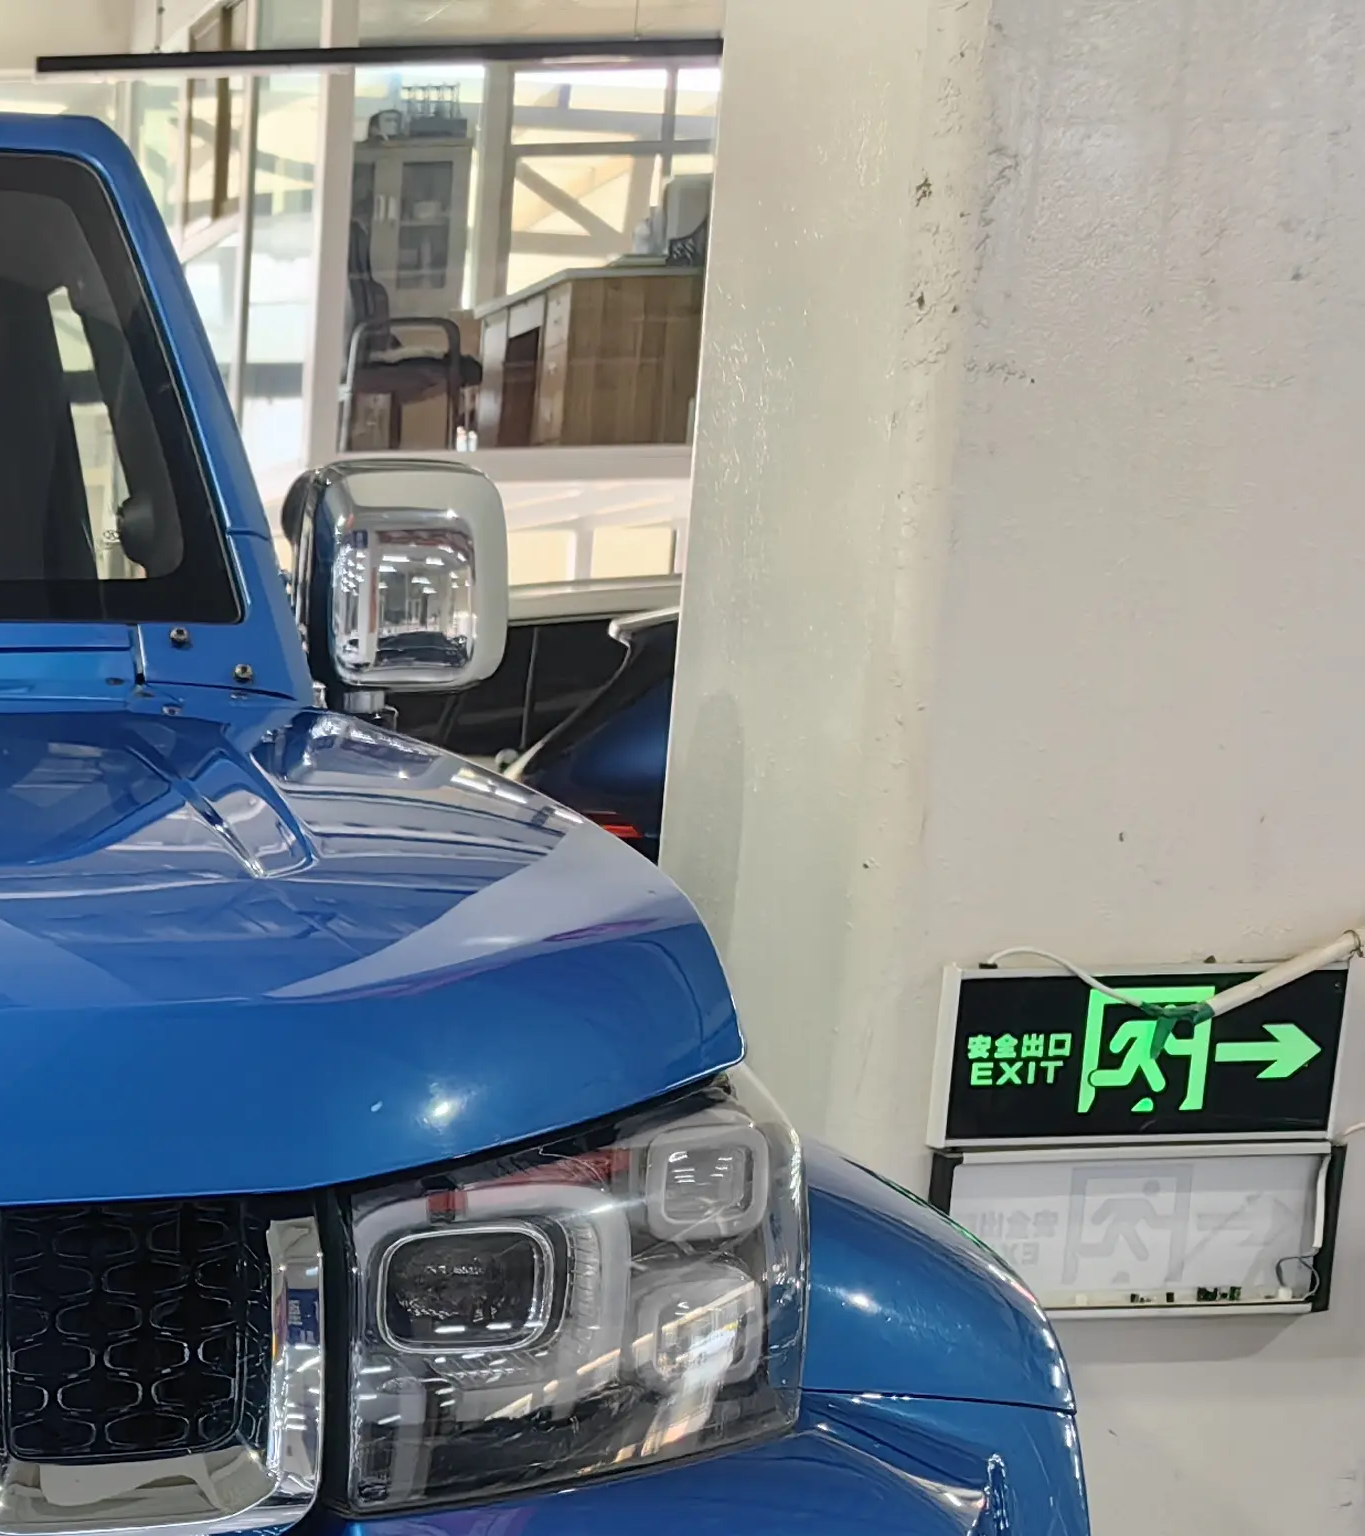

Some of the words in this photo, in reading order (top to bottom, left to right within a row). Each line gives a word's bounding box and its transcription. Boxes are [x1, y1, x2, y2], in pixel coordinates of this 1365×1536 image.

[967, 1032, 1072, 1059] 安全出口
[970, 1060, 1064, 1086] EXIT
